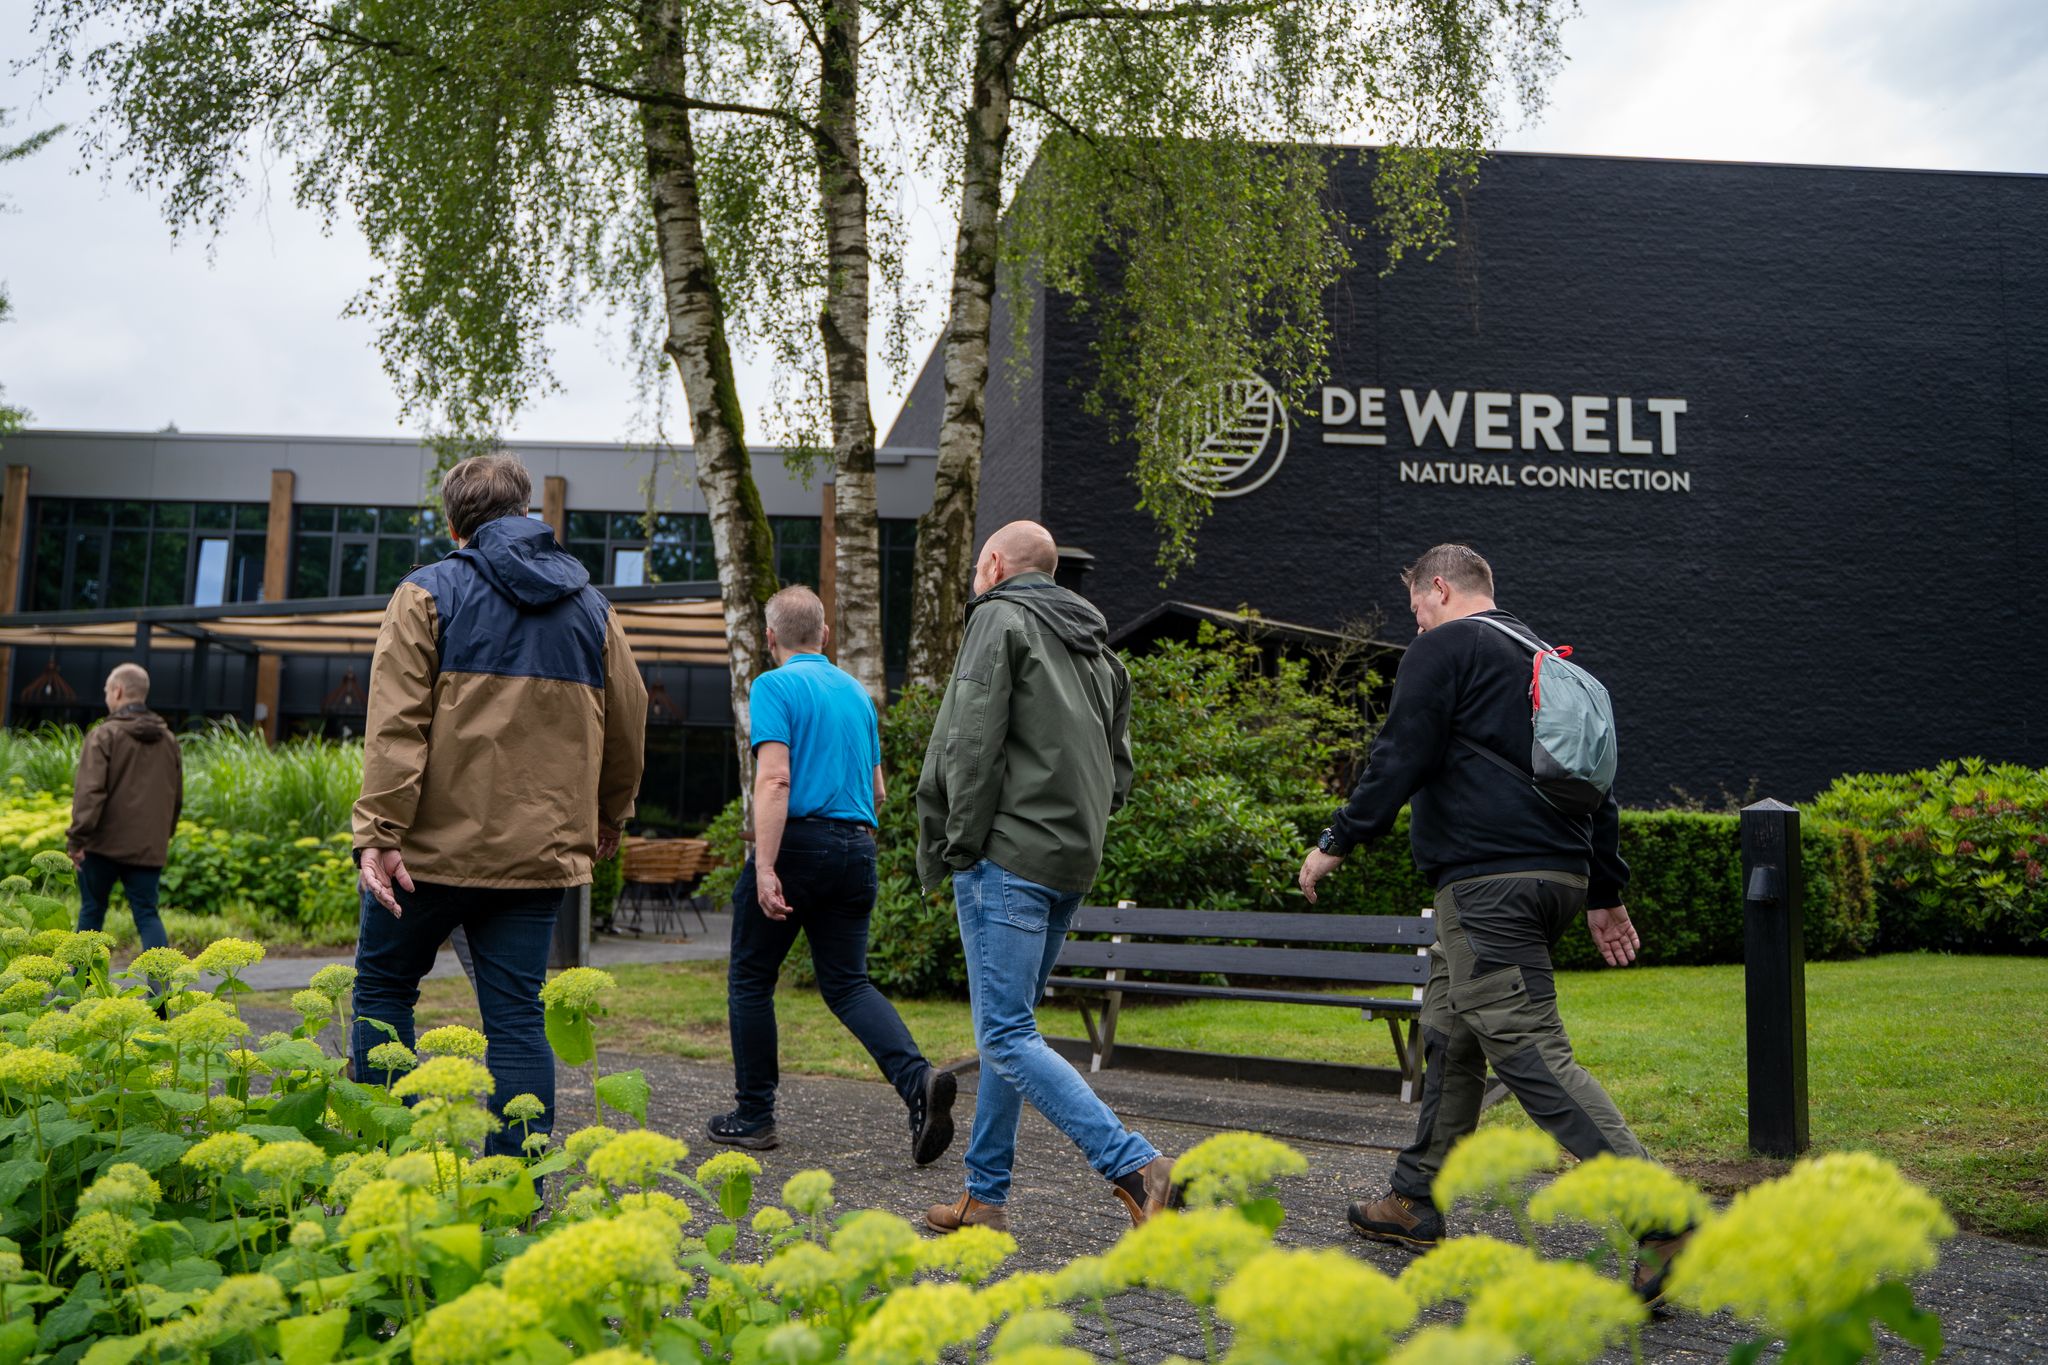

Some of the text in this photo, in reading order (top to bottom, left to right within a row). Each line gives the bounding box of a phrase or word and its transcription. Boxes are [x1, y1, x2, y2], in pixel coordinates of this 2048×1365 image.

[1322, 386, 1688, 455] DE WERELT
[1400, 461, 1690, 492] NATURAL CONNECTION
